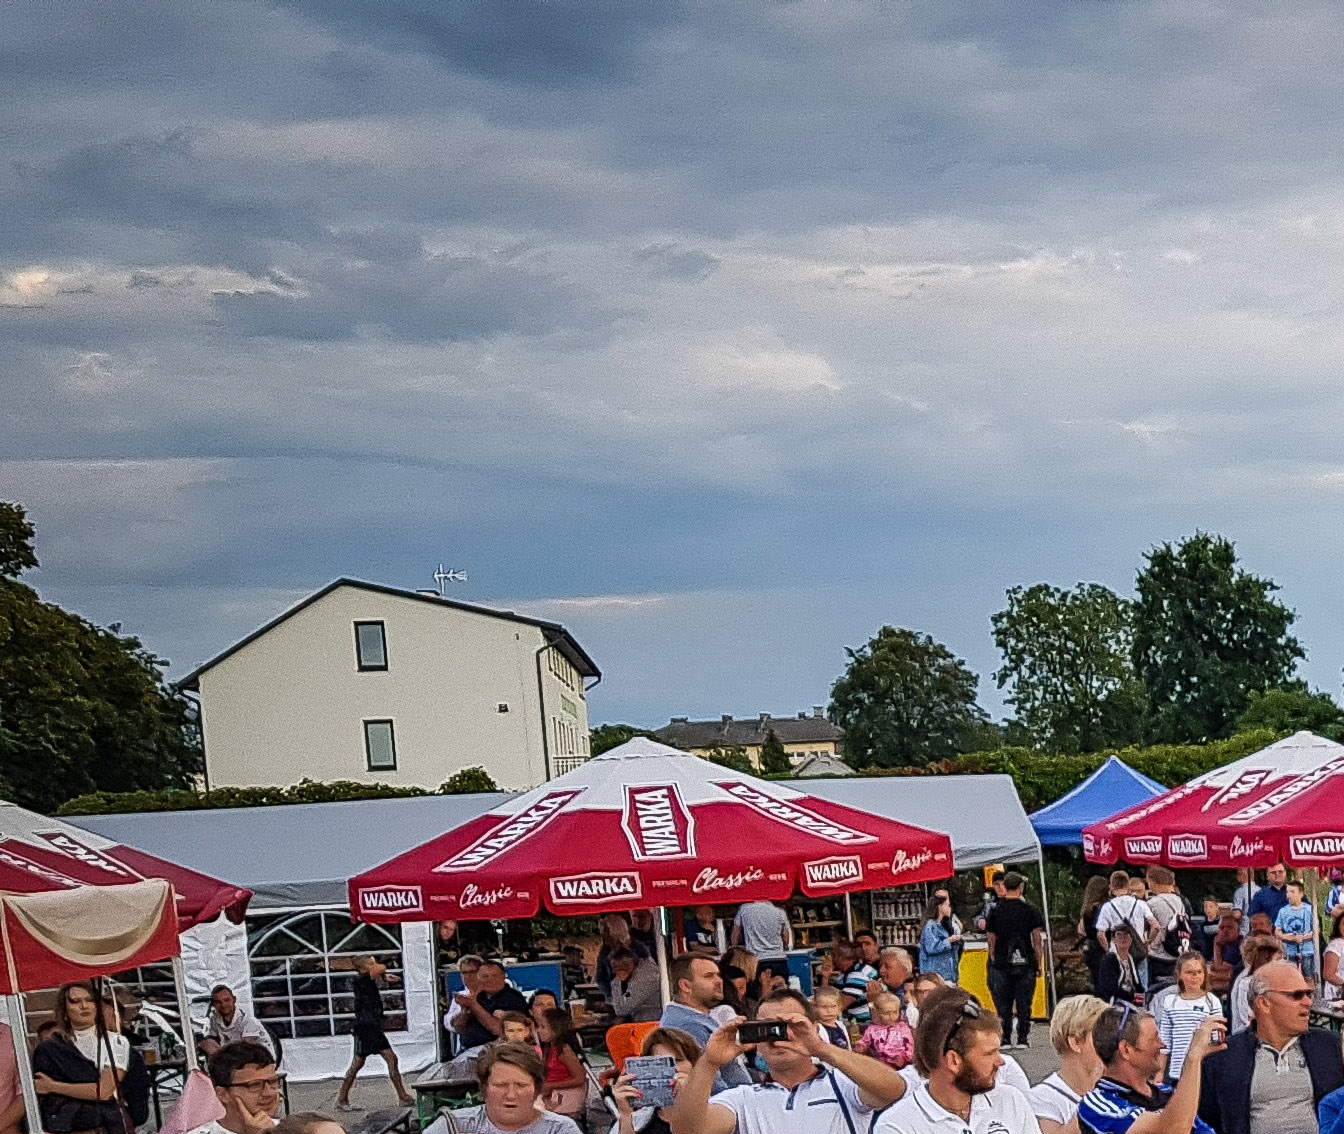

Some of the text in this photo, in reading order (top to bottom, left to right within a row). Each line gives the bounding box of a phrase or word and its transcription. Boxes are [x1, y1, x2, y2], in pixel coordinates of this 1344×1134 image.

[448, 792, 575, 868] WARKA
[637, 788, 682, 856] WARKA
[728, 785, 857, 841] WARKA
[807, 846, 932, 881] WARKA Classic
[1170, 834, 1265, 860] WARKA Classic
[363, 882, 515, 910] WARKA Classic
[555, 876, 634, 899] WARKA
[692, 864, 766, 894] Classic
